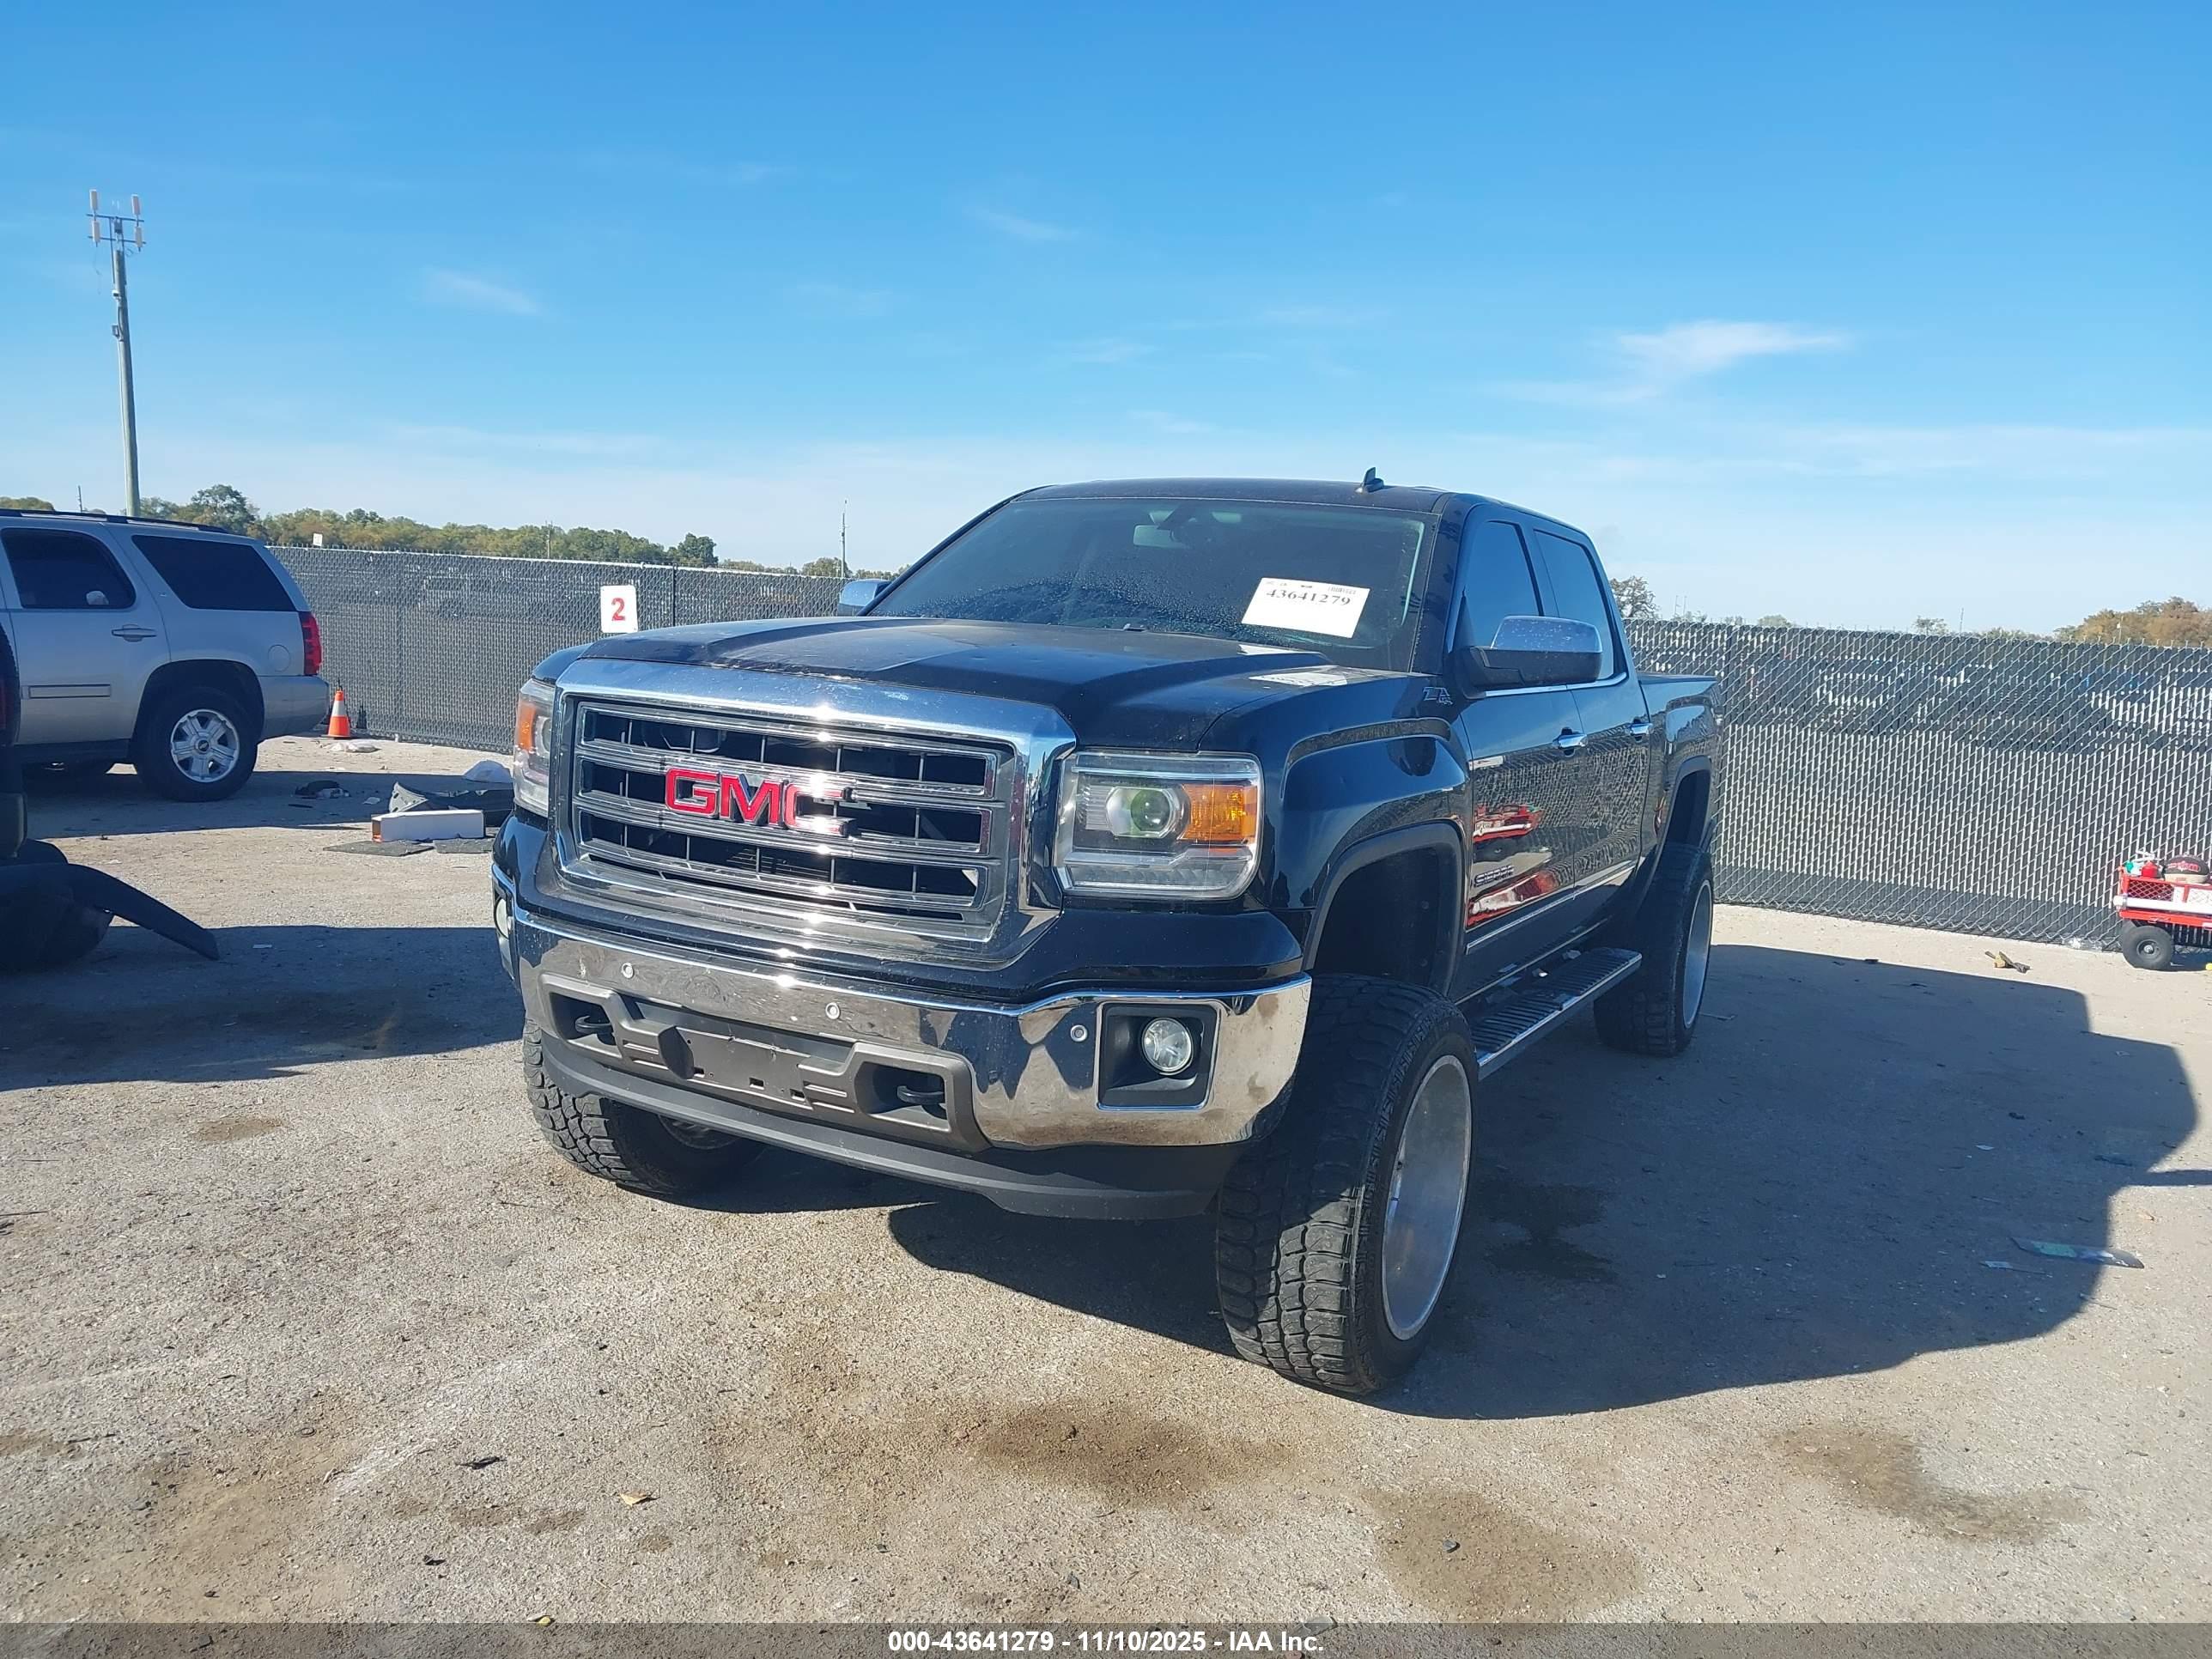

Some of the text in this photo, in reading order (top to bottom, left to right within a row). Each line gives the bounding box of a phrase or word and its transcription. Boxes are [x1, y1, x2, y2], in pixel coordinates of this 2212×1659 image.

[611, 597, 626, 622] 2
[1266, 588, 1352, 606] 43641279
[665, 767, 846, 837] GMC
